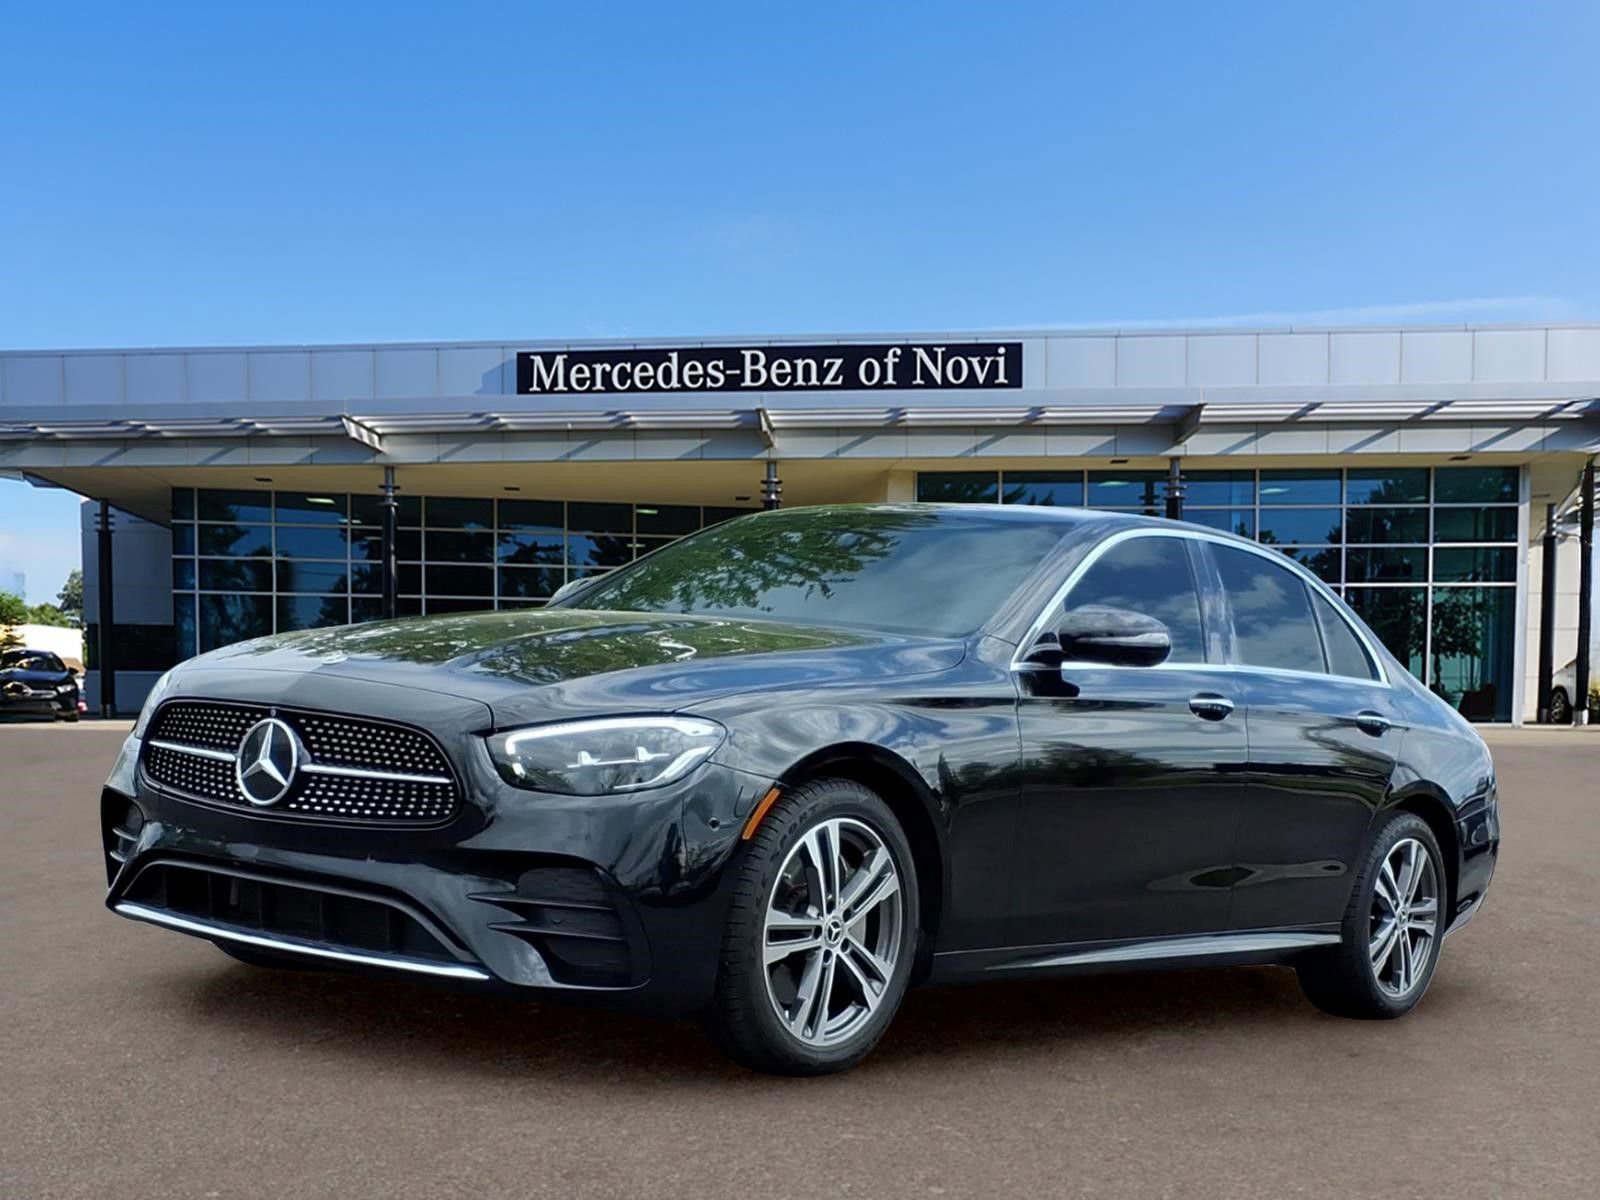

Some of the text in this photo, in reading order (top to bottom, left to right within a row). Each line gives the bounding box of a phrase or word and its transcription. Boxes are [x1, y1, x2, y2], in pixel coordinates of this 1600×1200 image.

[529, 346, 1008, 392] Mercedes-Benz of Novi
